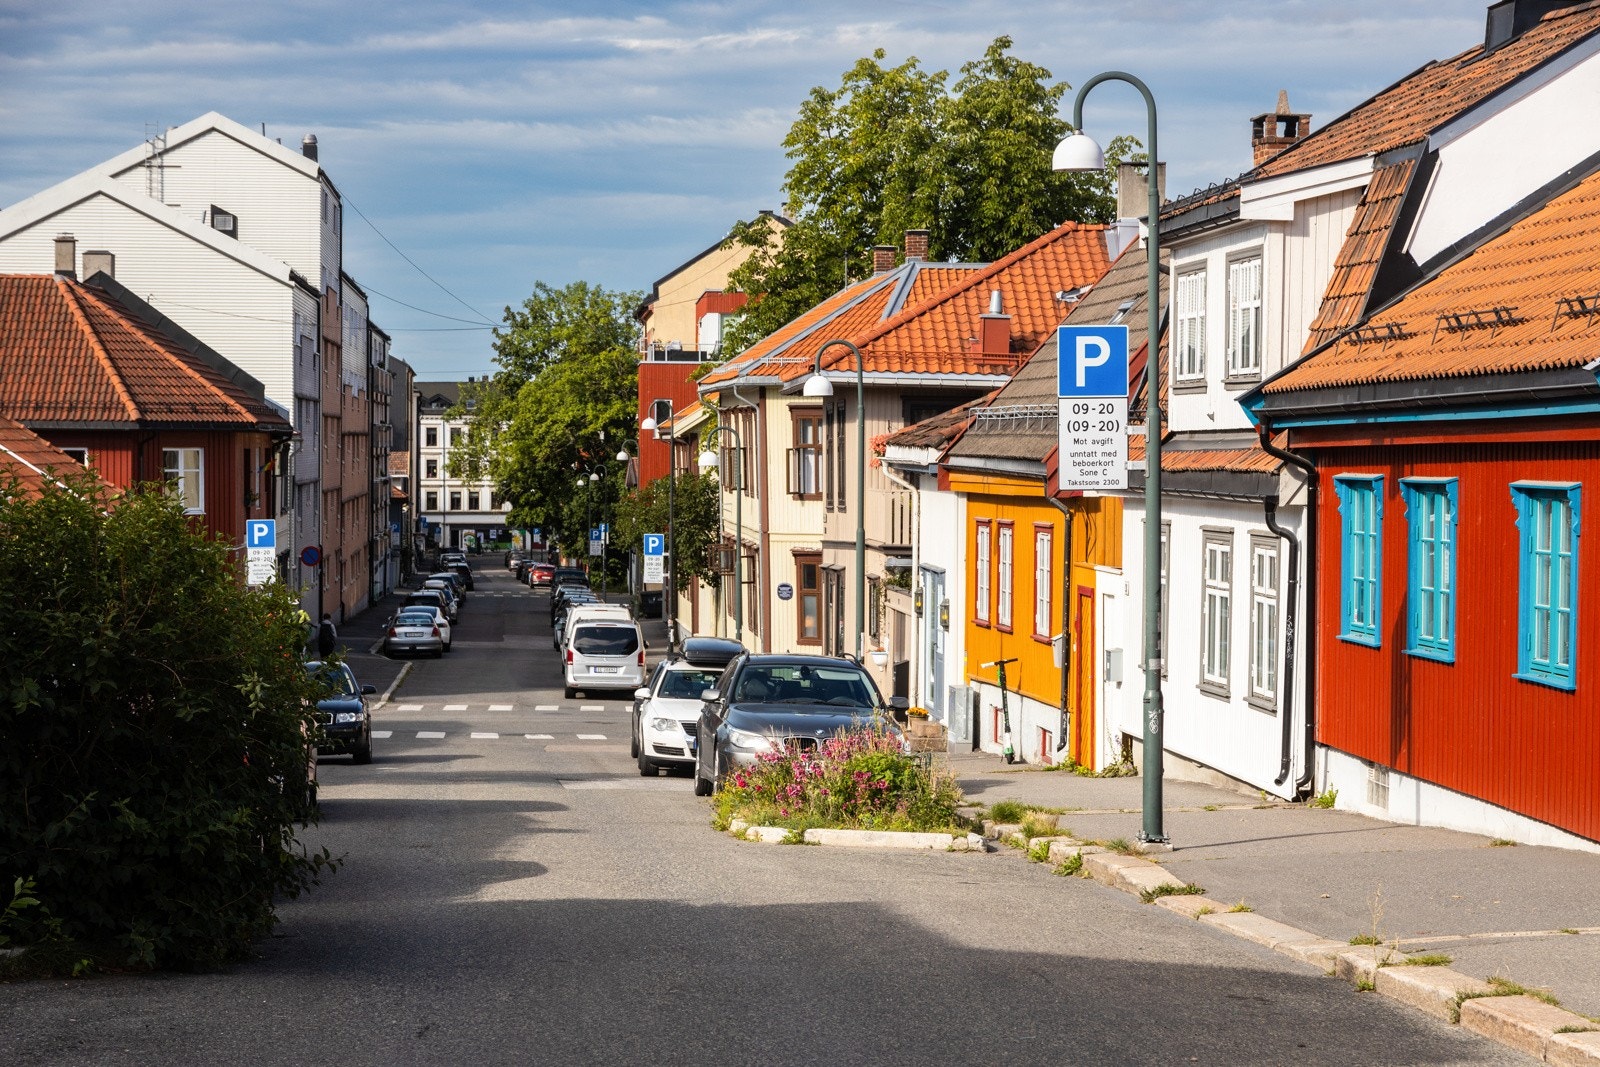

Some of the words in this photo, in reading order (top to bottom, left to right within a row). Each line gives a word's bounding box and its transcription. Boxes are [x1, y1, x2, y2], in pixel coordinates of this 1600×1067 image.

[1076, 336, 1111, 387] P
[1072, 403, 1114, 415] 09-20
[1067, 420, 1120, 433] (09-20)
[1091, 437, 1114, 447] avgift
[1069, 450, 1098, 458] unntatt
[1101, 450, 1117, 458] med
[1072, 459, 1114, 467] beboerkort
[254, 524, 268, 544] P
[592, 530, 599, 539] P
[648, 537, 659, 553] P
